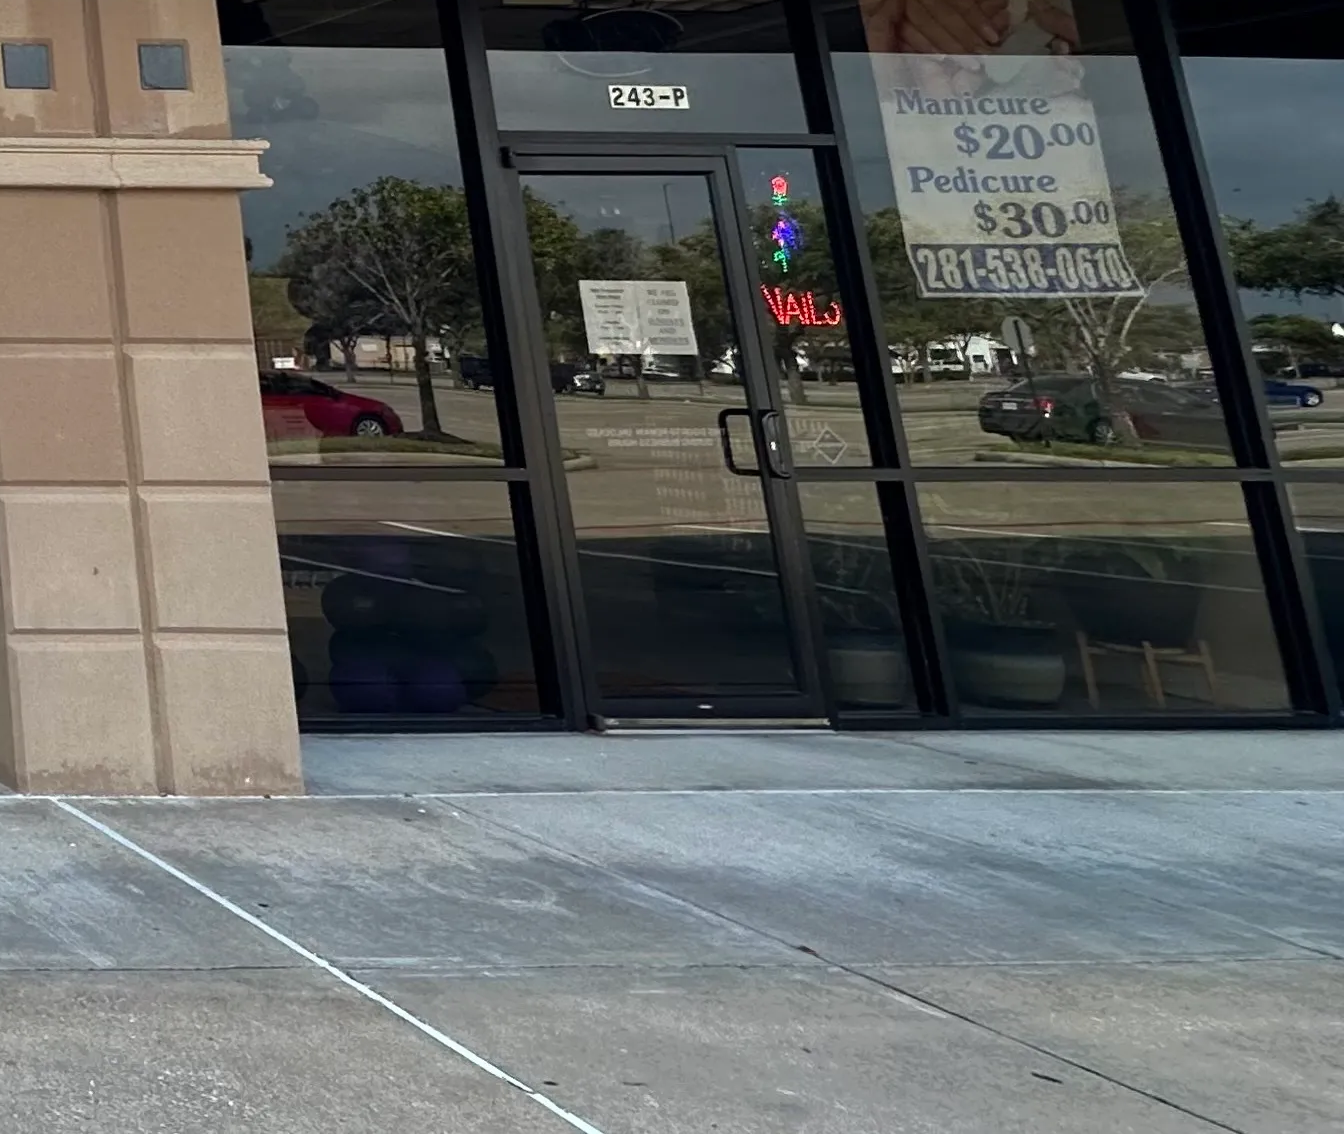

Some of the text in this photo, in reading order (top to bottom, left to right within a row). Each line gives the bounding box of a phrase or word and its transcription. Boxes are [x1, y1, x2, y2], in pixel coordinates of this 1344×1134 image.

[611, 87, 685, 107] 243-P
[894, 88, 1052, 116] Manicure
[953, 121, 1095, 161] $20.00
[906, 165, 1058, 194] Pedicure
[972, 199, 1110, 239] $30.00
